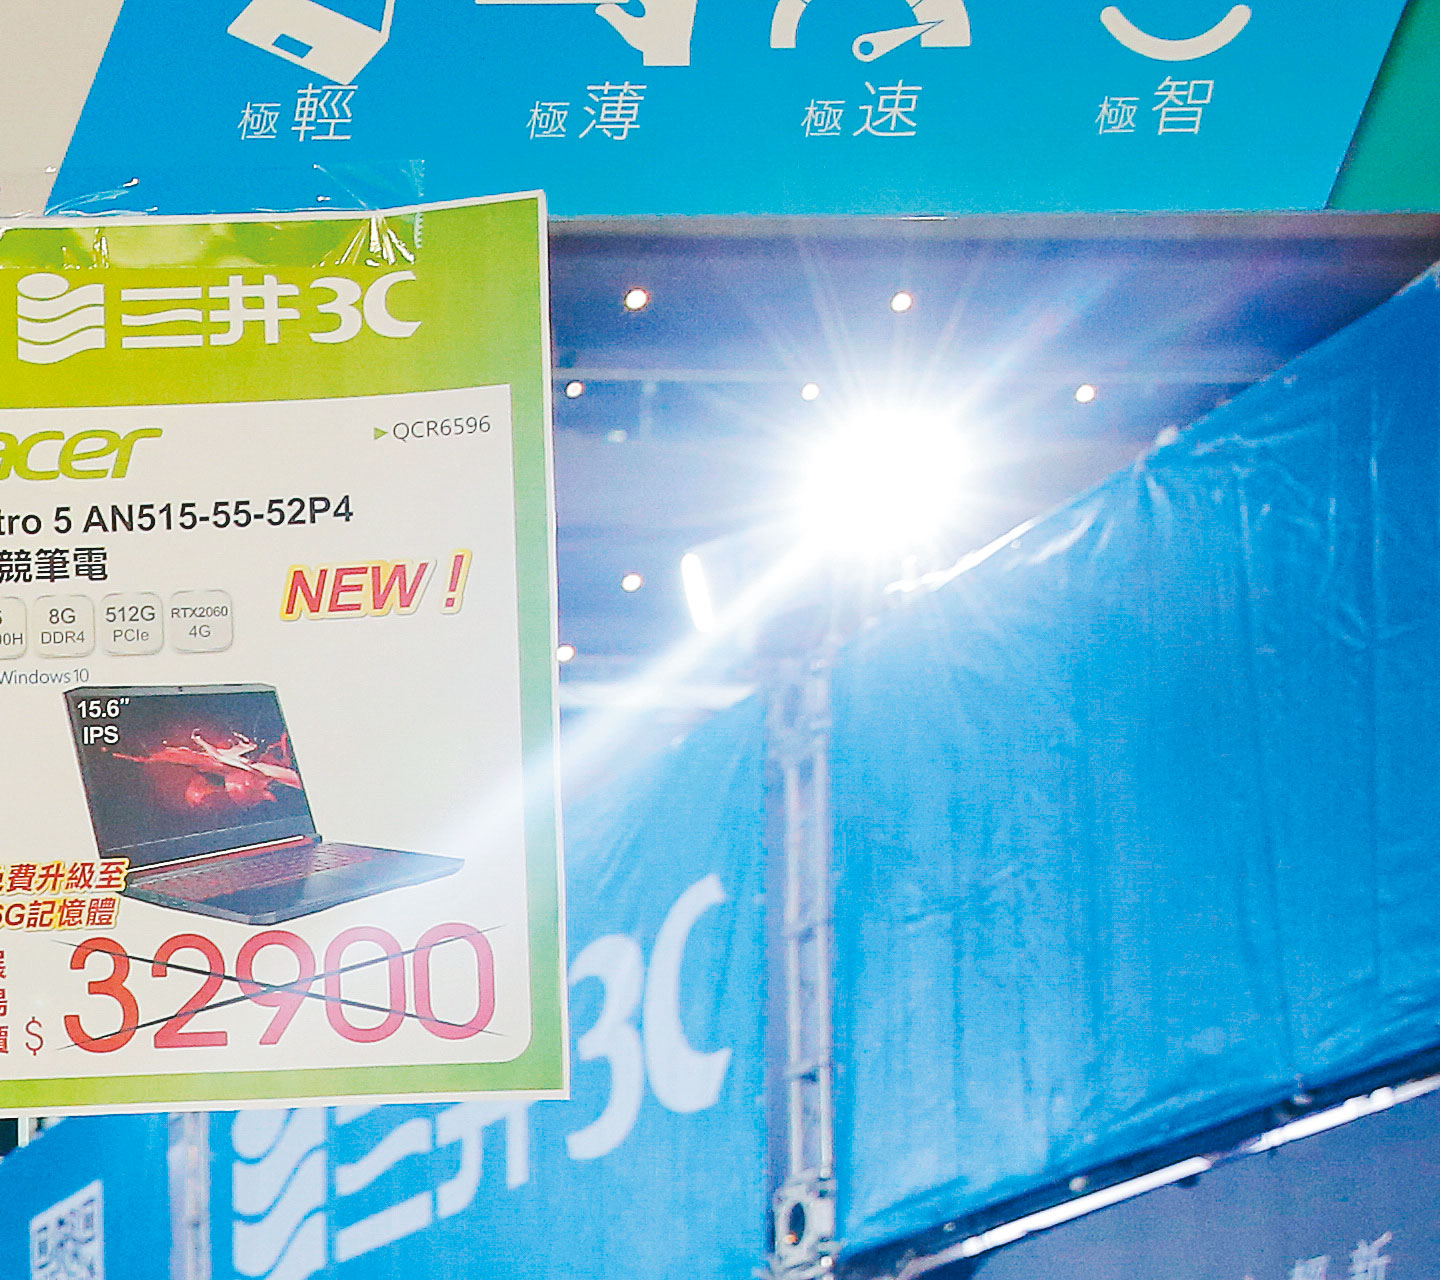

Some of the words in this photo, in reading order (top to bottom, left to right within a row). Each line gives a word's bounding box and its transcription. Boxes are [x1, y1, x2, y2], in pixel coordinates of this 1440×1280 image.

[120, 271, 423, 349] 三井3C
[392, 415, 492, 442] QCR6596
[54, 507, 73, 535] 5
[84, 494, 355, 534] AN515-55-52P4
[285, 560, 430, 616] NEW
[63, 922, 496, 1055] 32900
